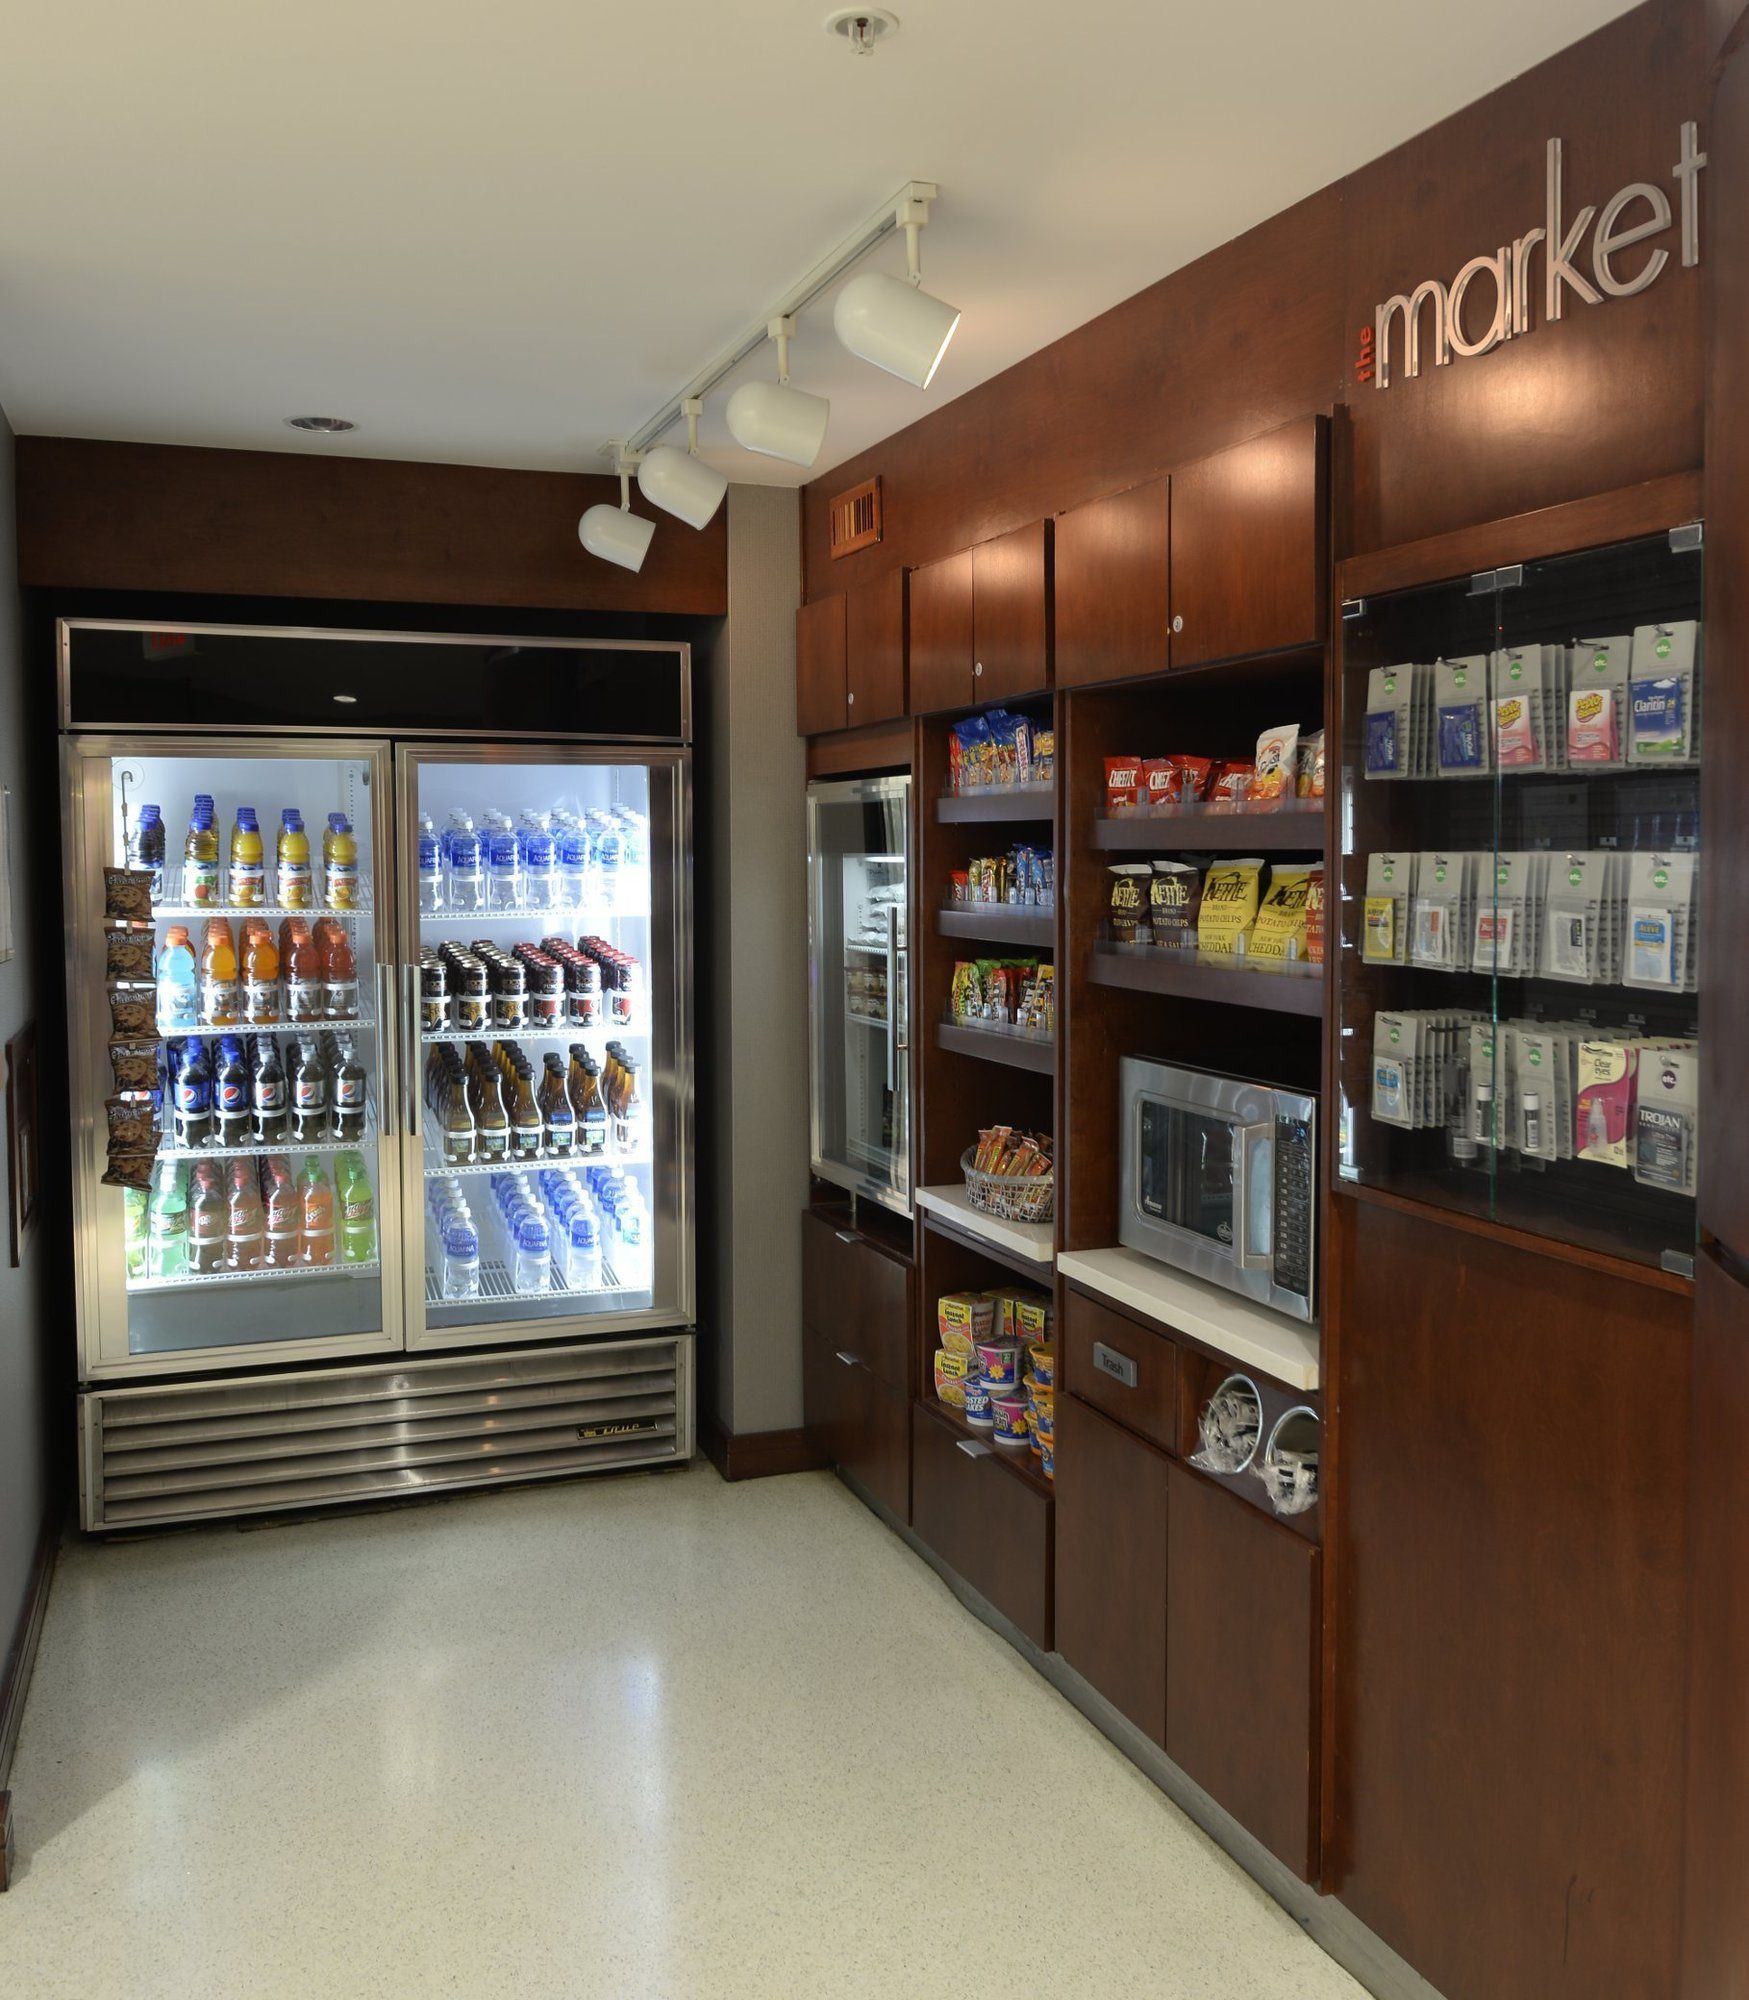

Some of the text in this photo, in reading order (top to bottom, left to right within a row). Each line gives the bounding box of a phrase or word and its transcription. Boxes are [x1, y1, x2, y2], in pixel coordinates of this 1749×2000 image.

[1375, 121, 1707, 389] market
[1355, 325, 1376, 382] the
[1634, 698, 1665, 712] Claritin
[1111, 878, 1140, 908] KETTLE
[1150, 876, 1190, 907] KETTLE
[1202, 872, 1249, 902] KETTLE
[1594, 1058, 1611, 1069] Clear
[1639, 1109, 1680, 1129] TROJAN
[1100, 1350, 1124, 1377] Trash
